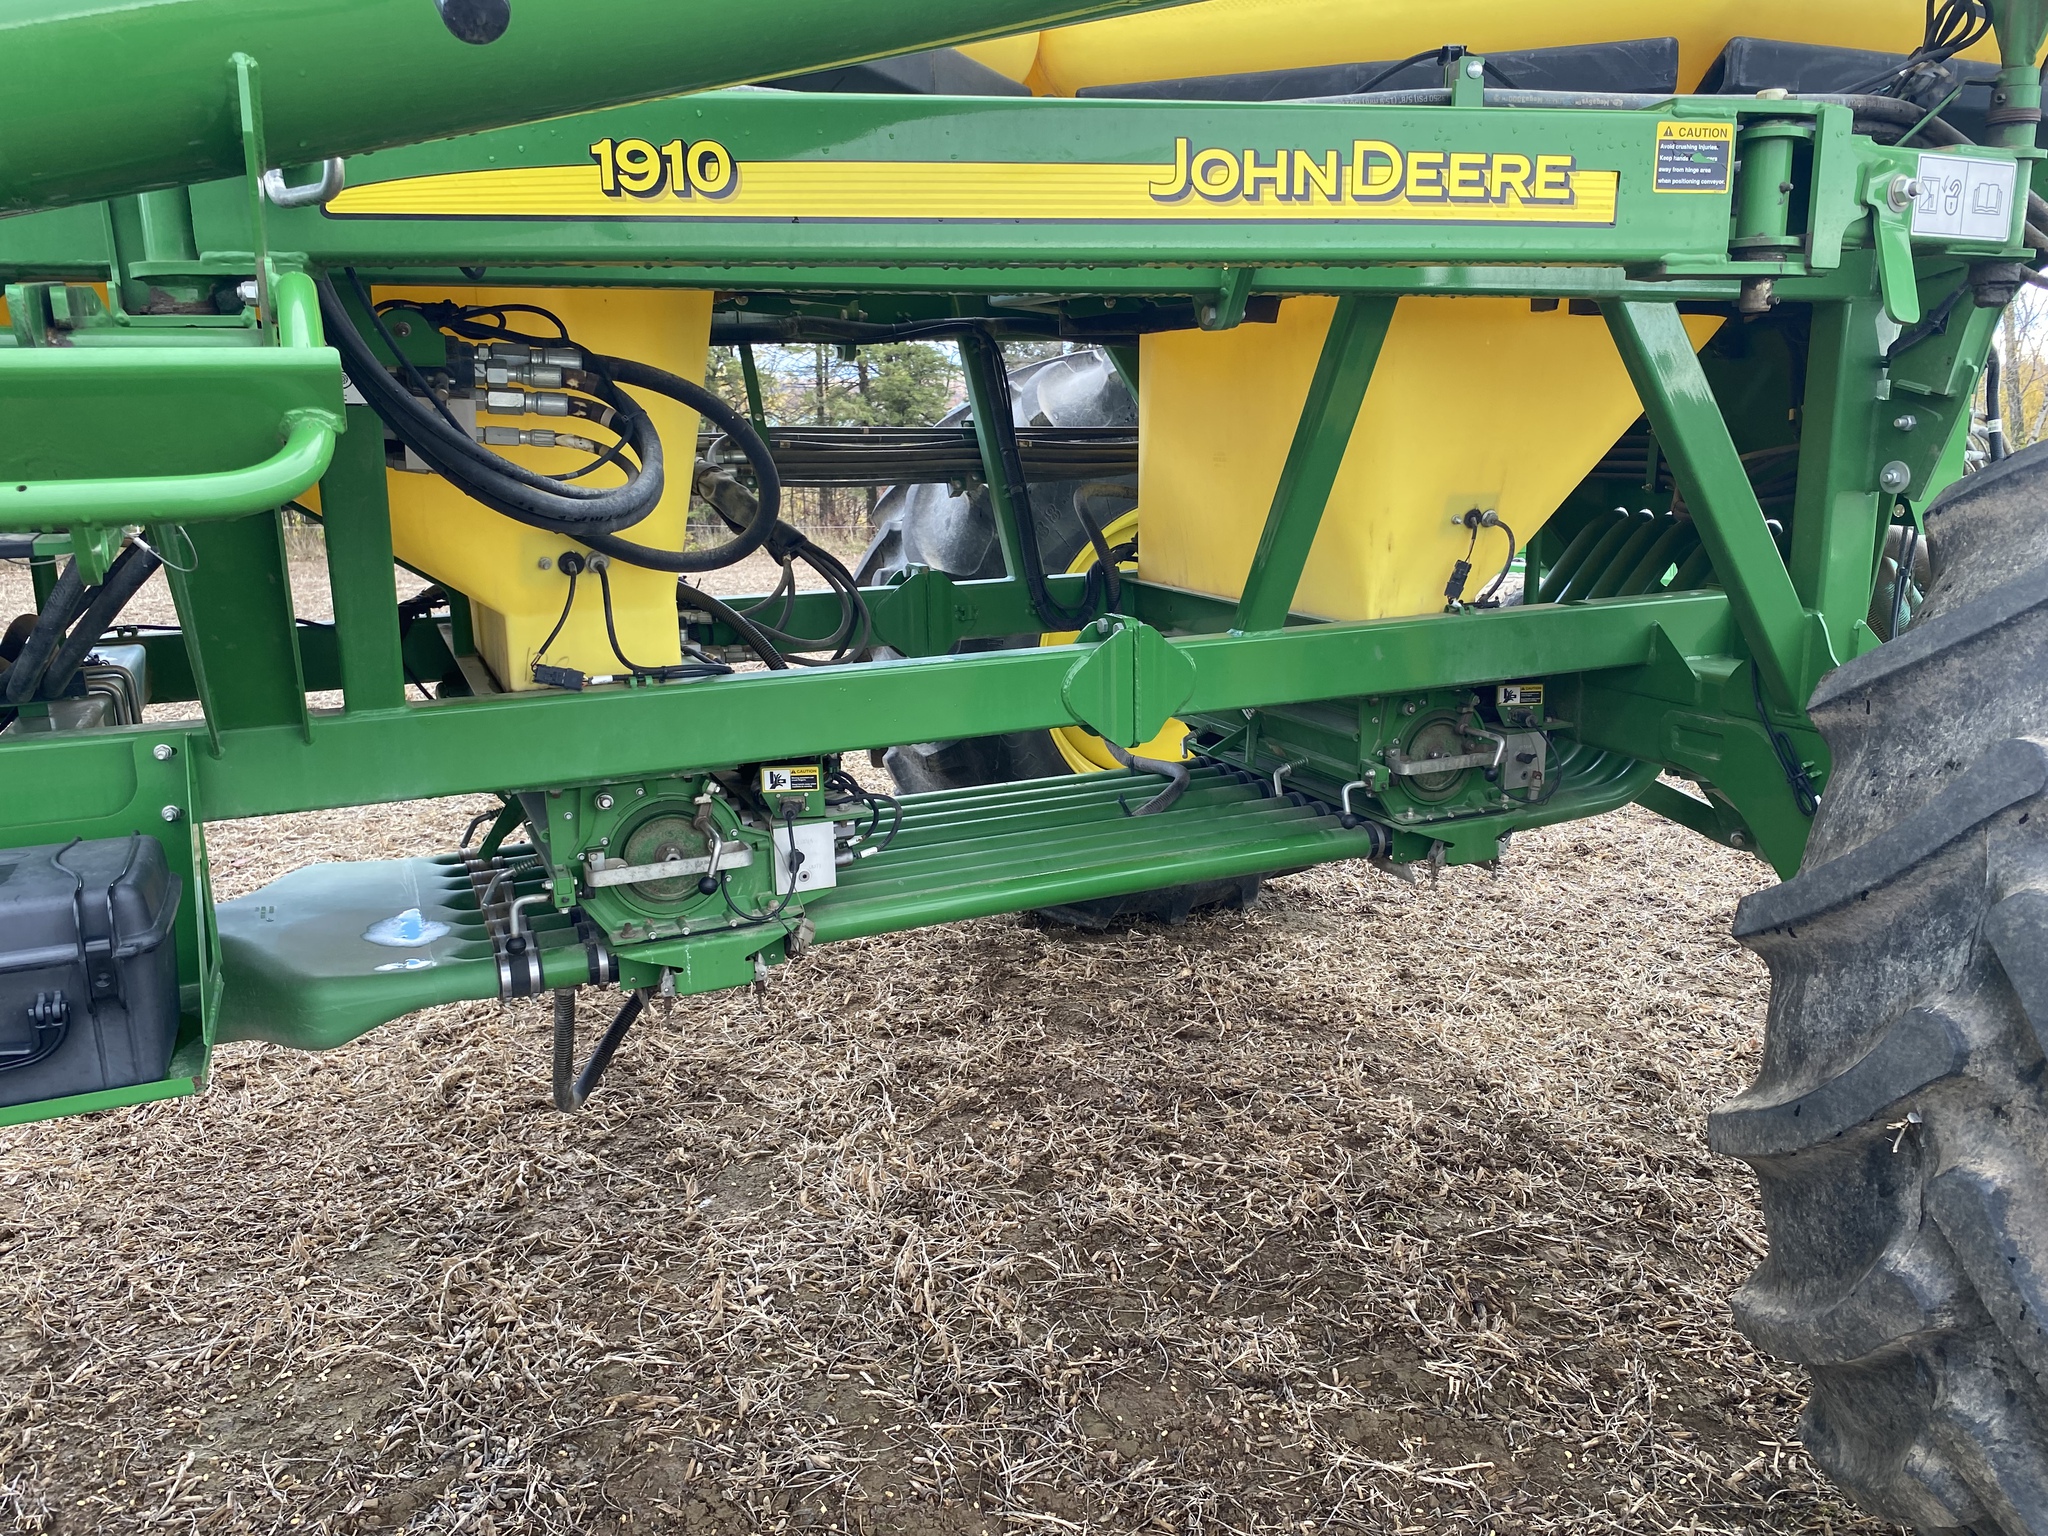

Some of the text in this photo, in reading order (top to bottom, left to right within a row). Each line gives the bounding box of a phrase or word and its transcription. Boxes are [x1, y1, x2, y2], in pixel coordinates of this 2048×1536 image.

[1678, 127, 1728, 138] CAUTION
[1675, 143, 1698, 151] crushing
[589, 138, 738, 200] 1910
[1149, 137, 1576, 206] JOHN DEERE
[1685, 166, 1699, 174] hinge
[1671, 178, 1700, 186] positioning
